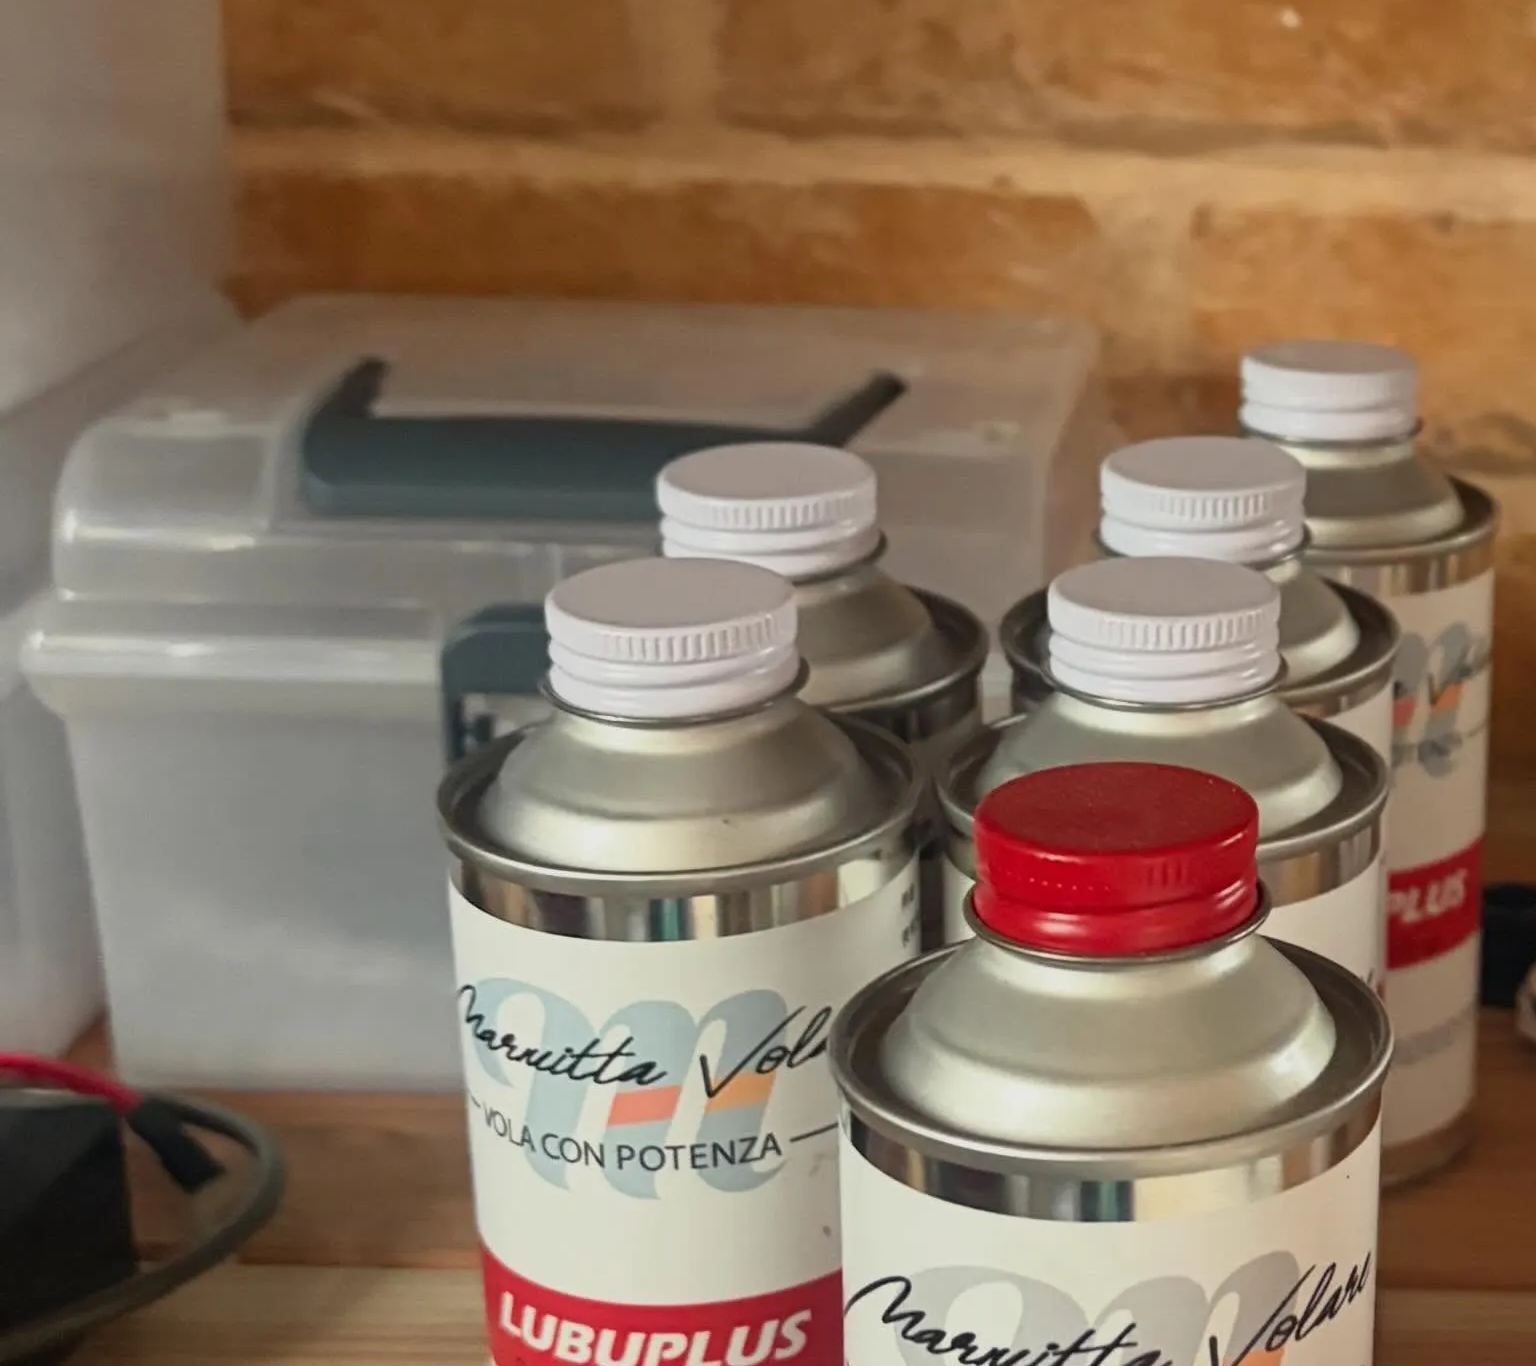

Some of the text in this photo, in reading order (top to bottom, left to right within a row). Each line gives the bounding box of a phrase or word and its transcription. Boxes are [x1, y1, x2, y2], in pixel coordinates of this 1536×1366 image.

[483, 1106, 783, 1172] VOLA CON POTENZA
